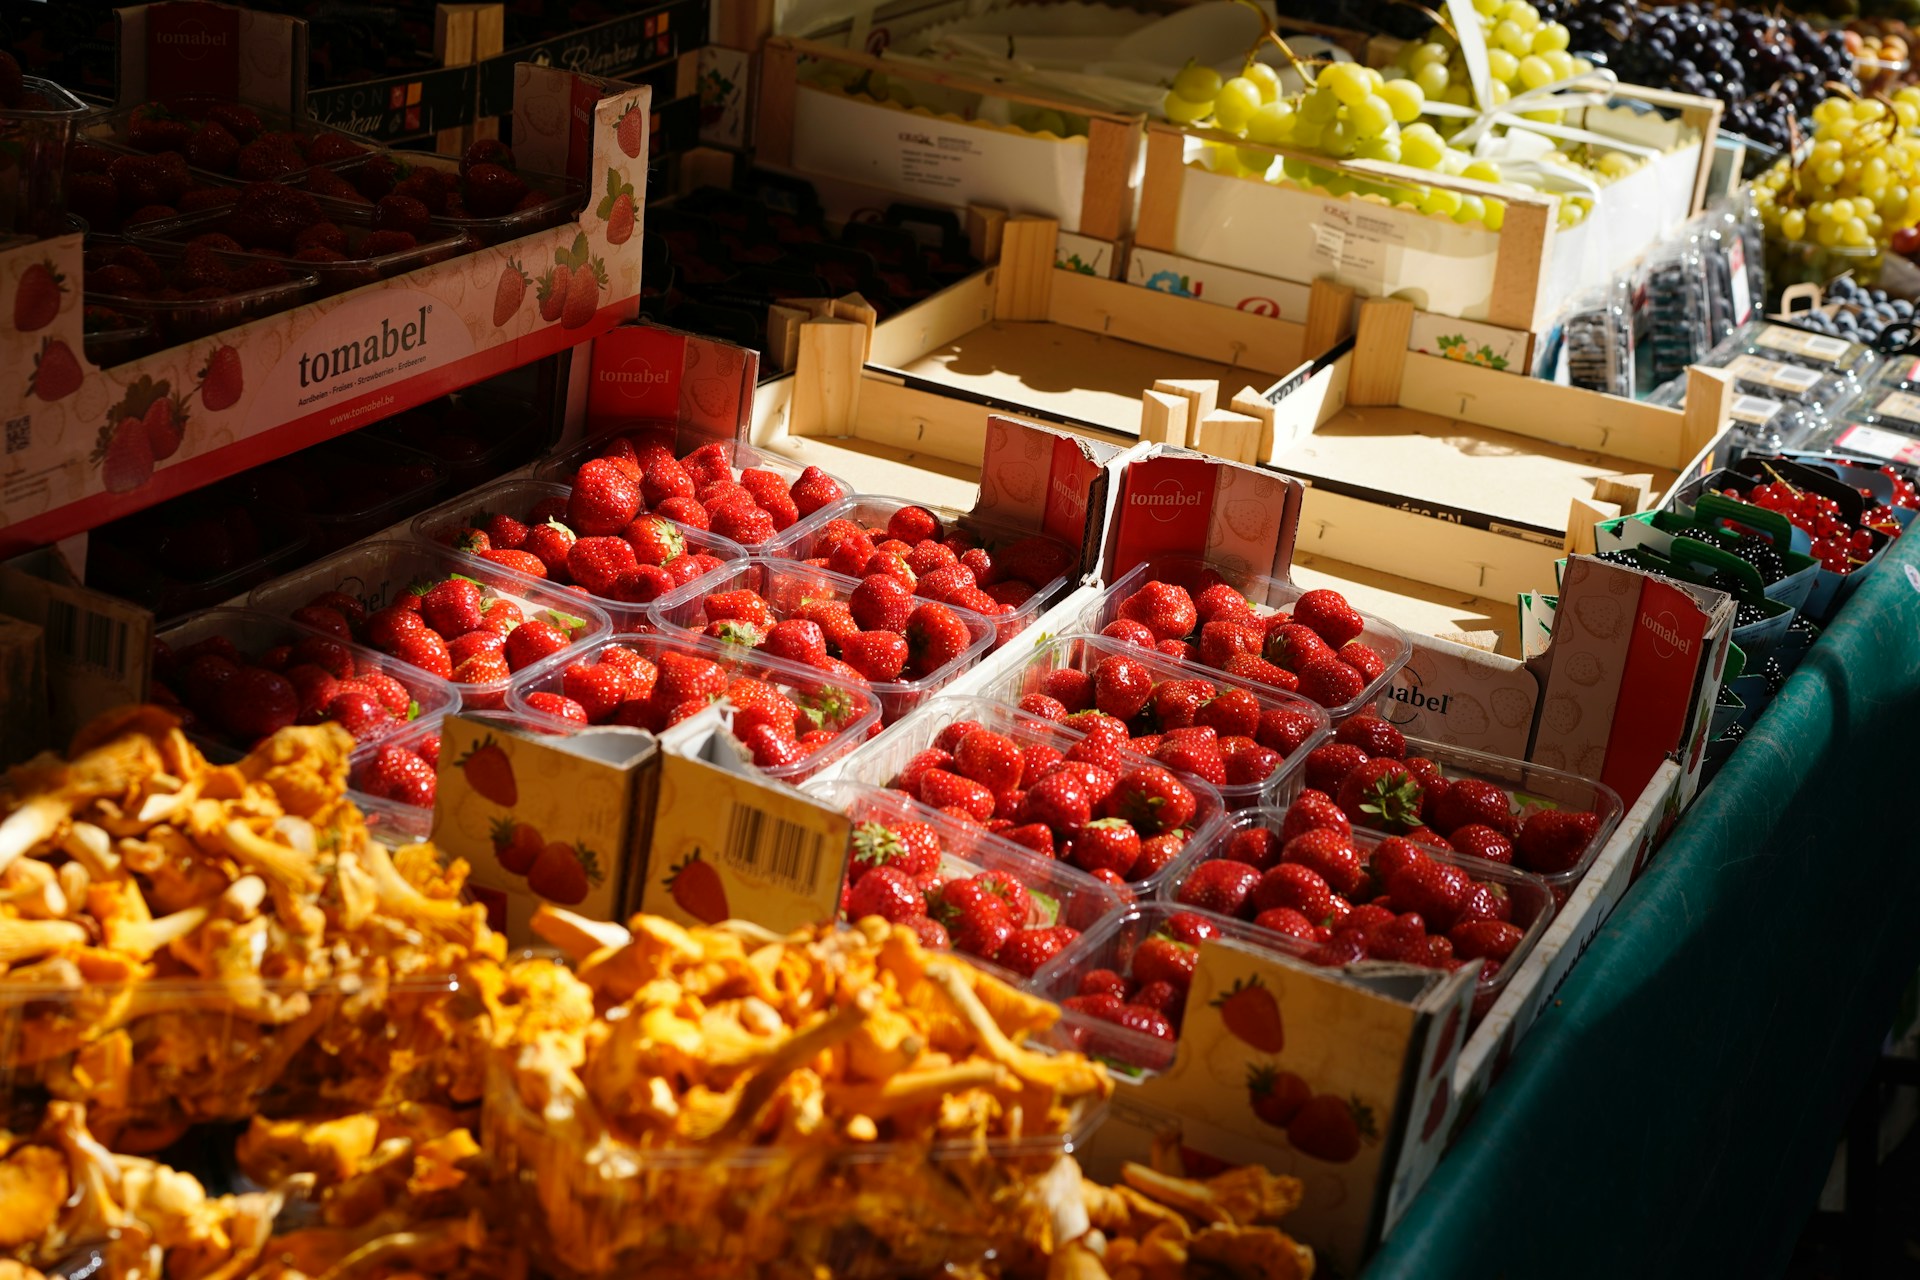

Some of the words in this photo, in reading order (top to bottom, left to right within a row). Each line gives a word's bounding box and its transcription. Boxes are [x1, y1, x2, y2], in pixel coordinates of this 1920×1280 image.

[156, 30, 227, 47] tomabel
[298, 391, 328, 407] Aardbeien
[332, 381, 354, 395] Fraises
[357, 366, 395, 386] Strawberries
[398, 355, 427, 371] Erdbeeren
[599, 369, 670, 384] tomabel
[329, 395, 395, 426] www.tomabel.be
[1130, 490, 1202, 506] tomabel
[1641, 611, 1691, 656] tomabel
